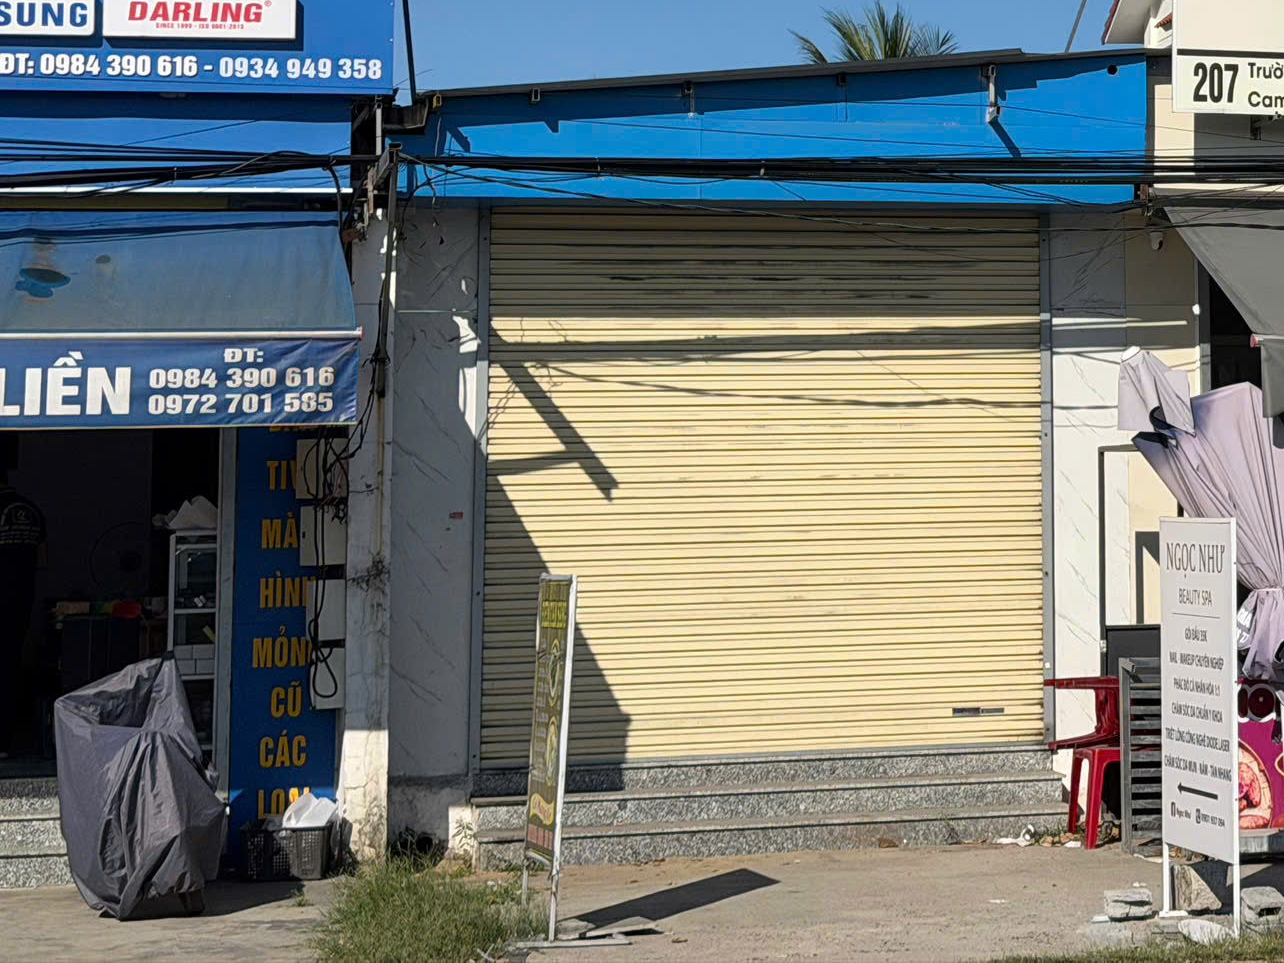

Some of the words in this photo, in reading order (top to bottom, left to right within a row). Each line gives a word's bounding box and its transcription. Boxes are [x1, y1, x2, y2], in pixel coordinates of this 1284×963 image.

[0, 1, 88, 28] SUNG
[40, 53, 100, 76] 0984
[107, 54, 150, 77] 390
[157, 55, 198, 78] 616
[219, 56, 279, 79] 0934
[287, 57, 332, 80] 949
[338, 57, 383, 80] 358
[1193, 62, 1239, 103] 207
[223, 347, 265, 363] ĐT:
[0, 350, 132, 416] LIỀN
[148, 368, 219, 390] 0984
[225, 368, 277, 389] 390
[284, 366, 335, 388] 616
[147, 394, 218, 415] 0972
[225, 393, 273, 415] 701
[284, 392, 334, 414] 585
[1166, 542, 1196, 579] NGỌC
[1198, 543, 1226, 574] NHƯ
[1178, 588, 1201, 606] BEAUTY
[1201, 590, 1213, 607] SPA
[270, 680, 302, 719] CŨ
[259, 729, 307, 769] CÁC
